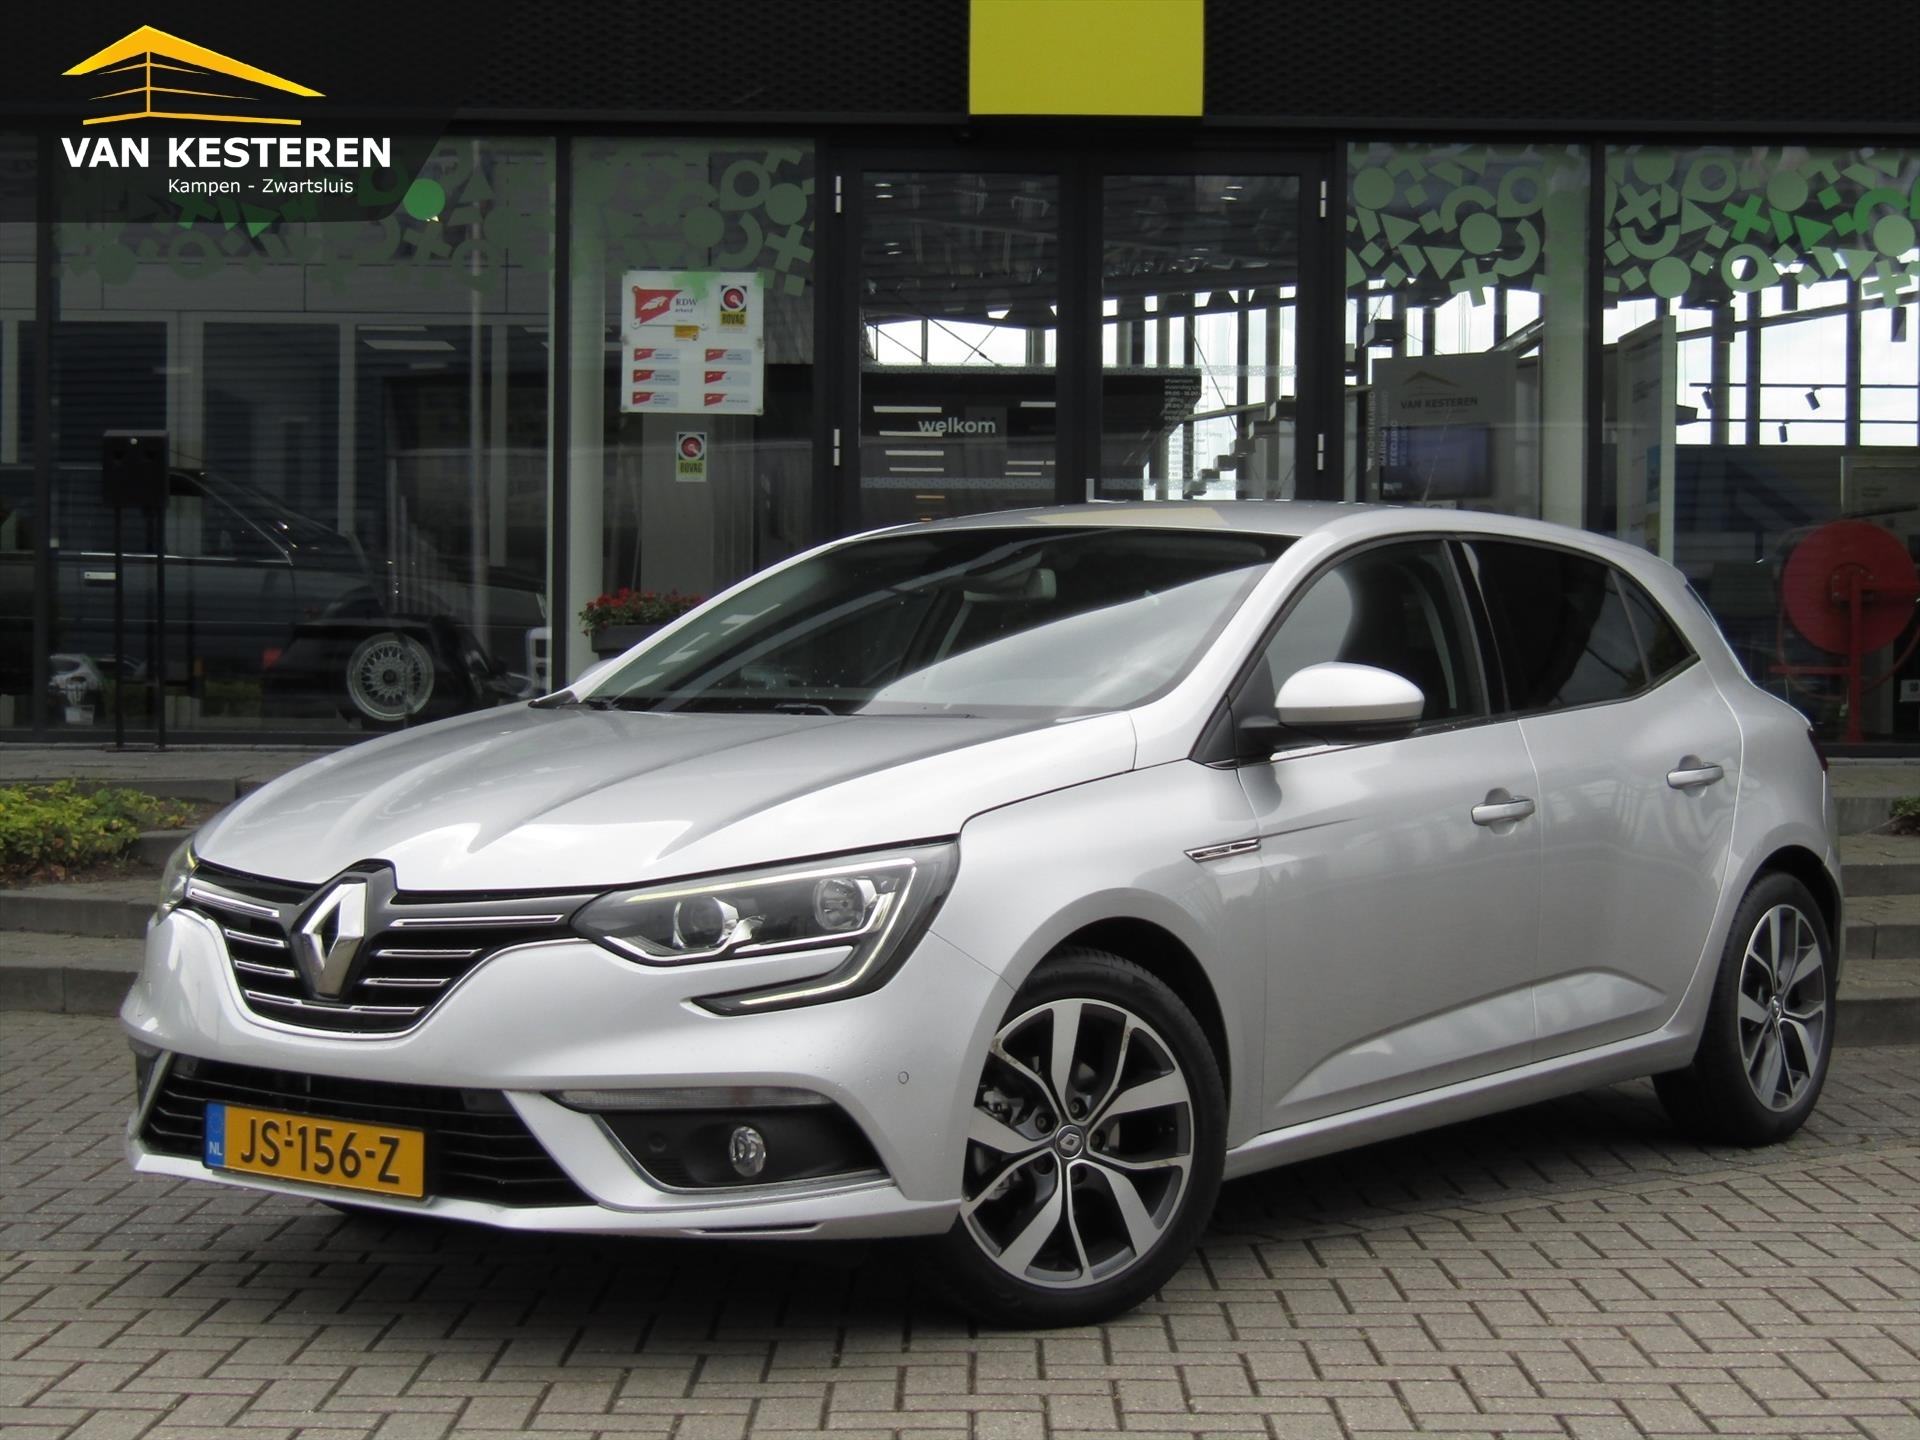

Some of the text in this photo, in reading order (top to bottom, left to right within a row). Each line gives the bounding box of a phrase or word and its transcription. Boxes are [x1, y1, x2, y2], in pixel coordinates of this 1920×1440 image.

[675, 297, 697, 306] RDW
[721, 313, 745, 325] BOVAG
[1400, 396, 1478, 409] VAN KESTEREN
[917, 416, 996, 434] welkom
[680, 462, 703, 474] BOVAG
[209, 1141, 223, 1157] NL
